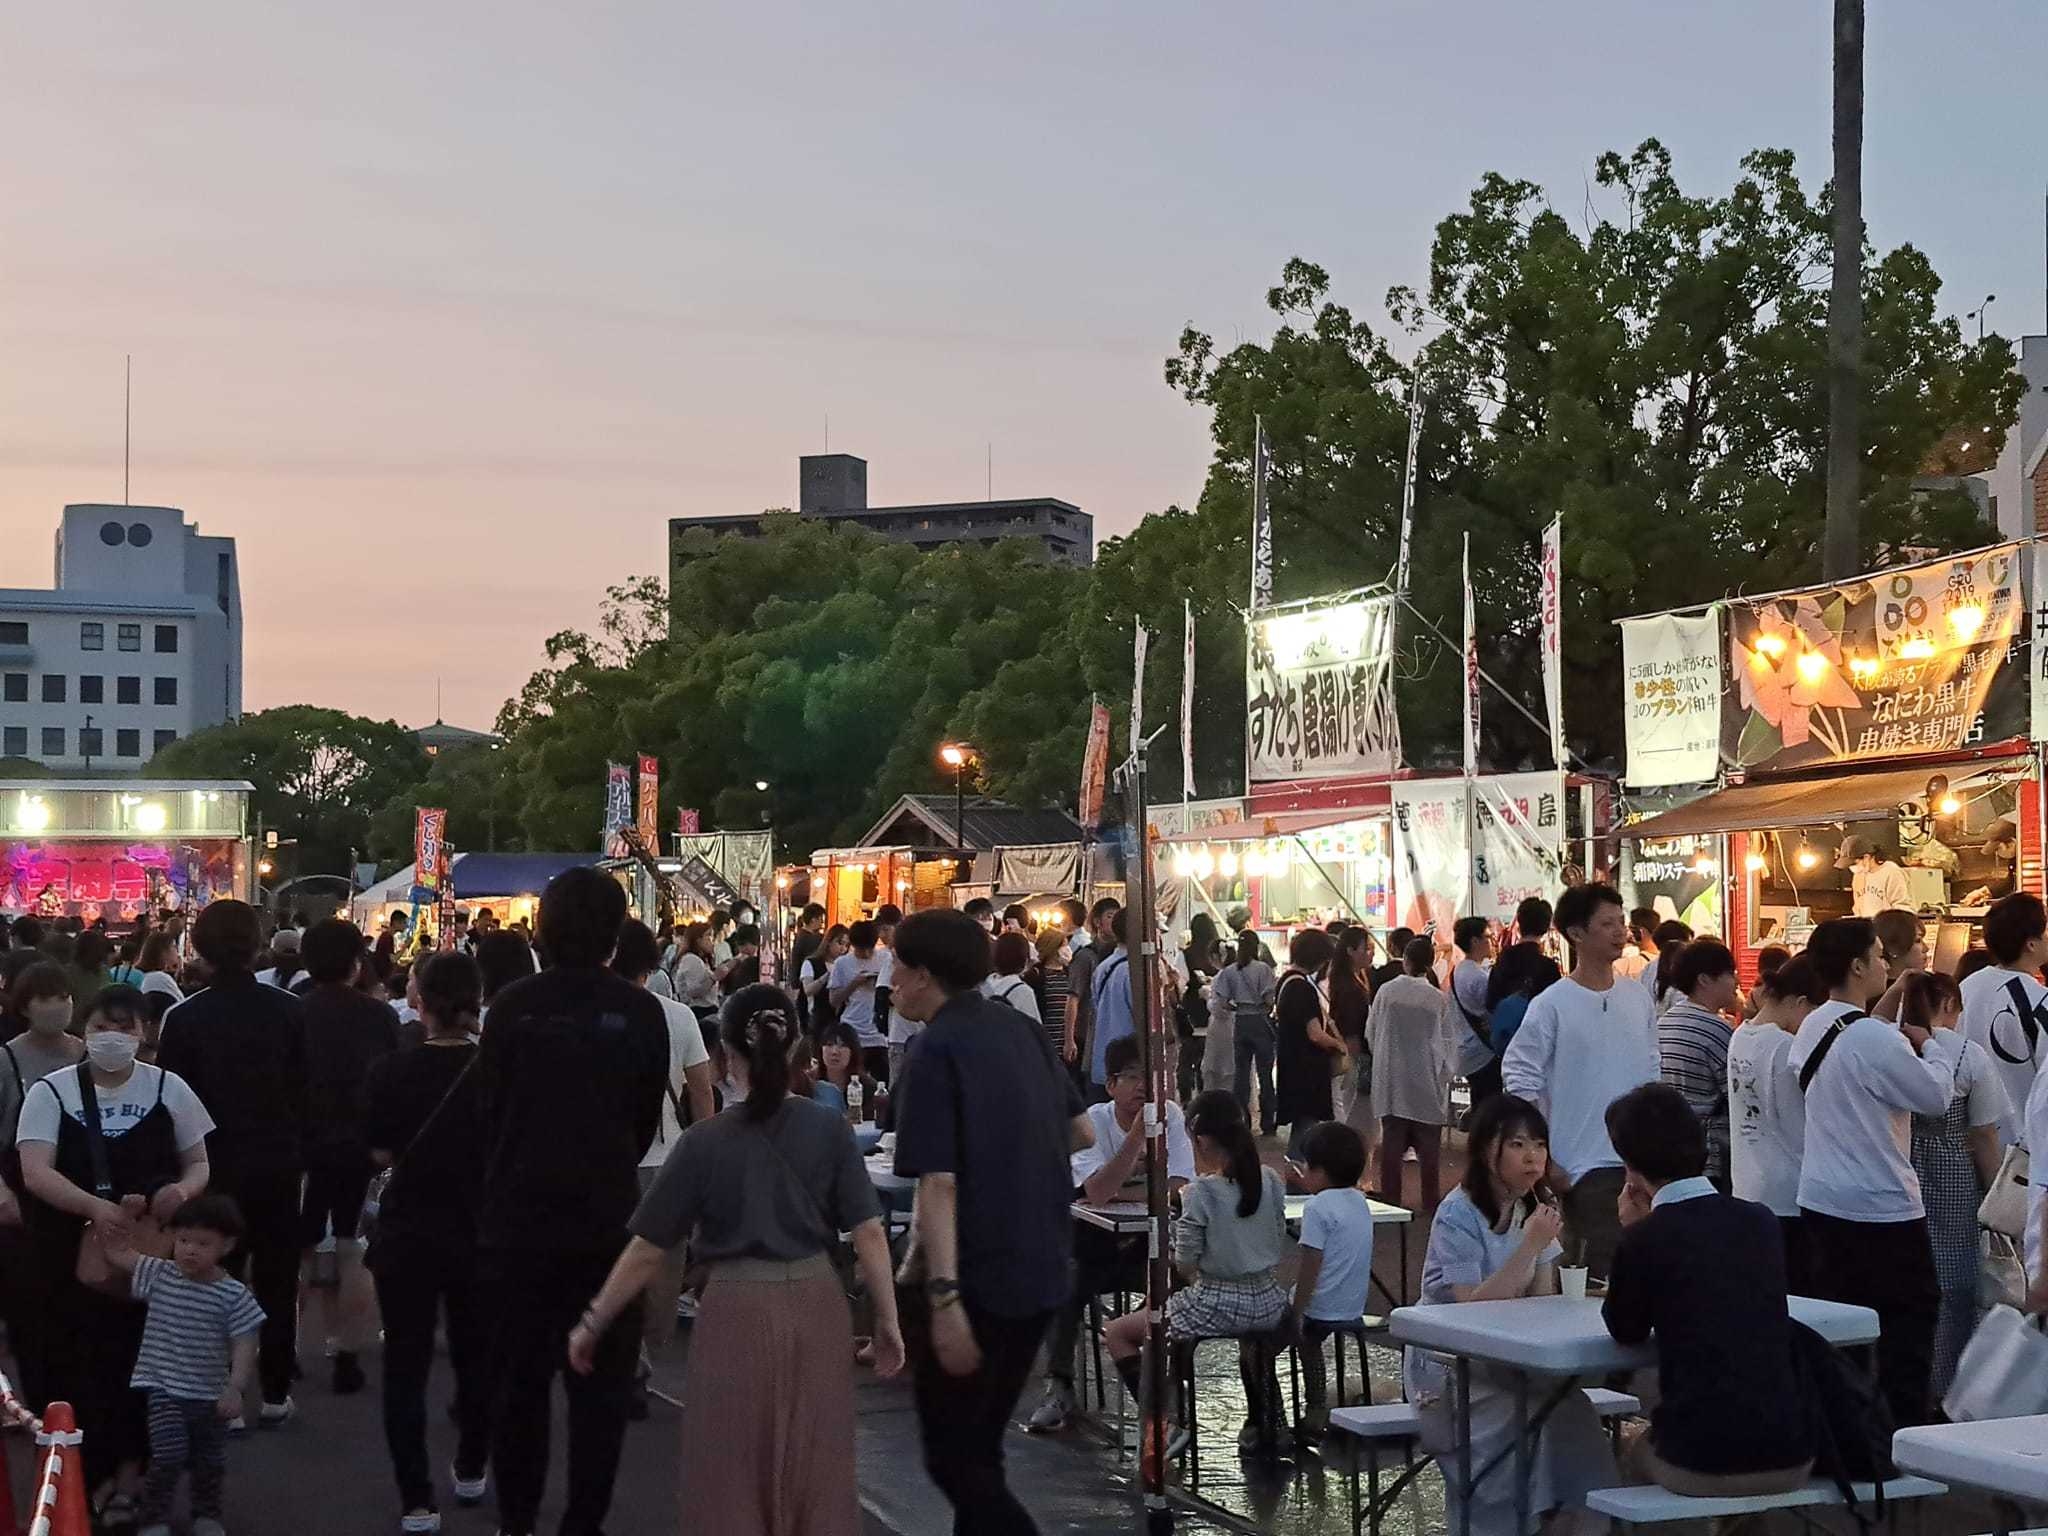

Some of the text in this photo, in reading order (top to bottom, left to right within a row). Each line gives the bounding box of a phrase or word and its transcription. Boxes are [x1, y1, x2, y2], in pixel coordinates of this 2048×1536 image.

[1872, 677, 1977, 724] なにわ黒牛
[1856, 710, 1985, 753] 串焼き専門店
